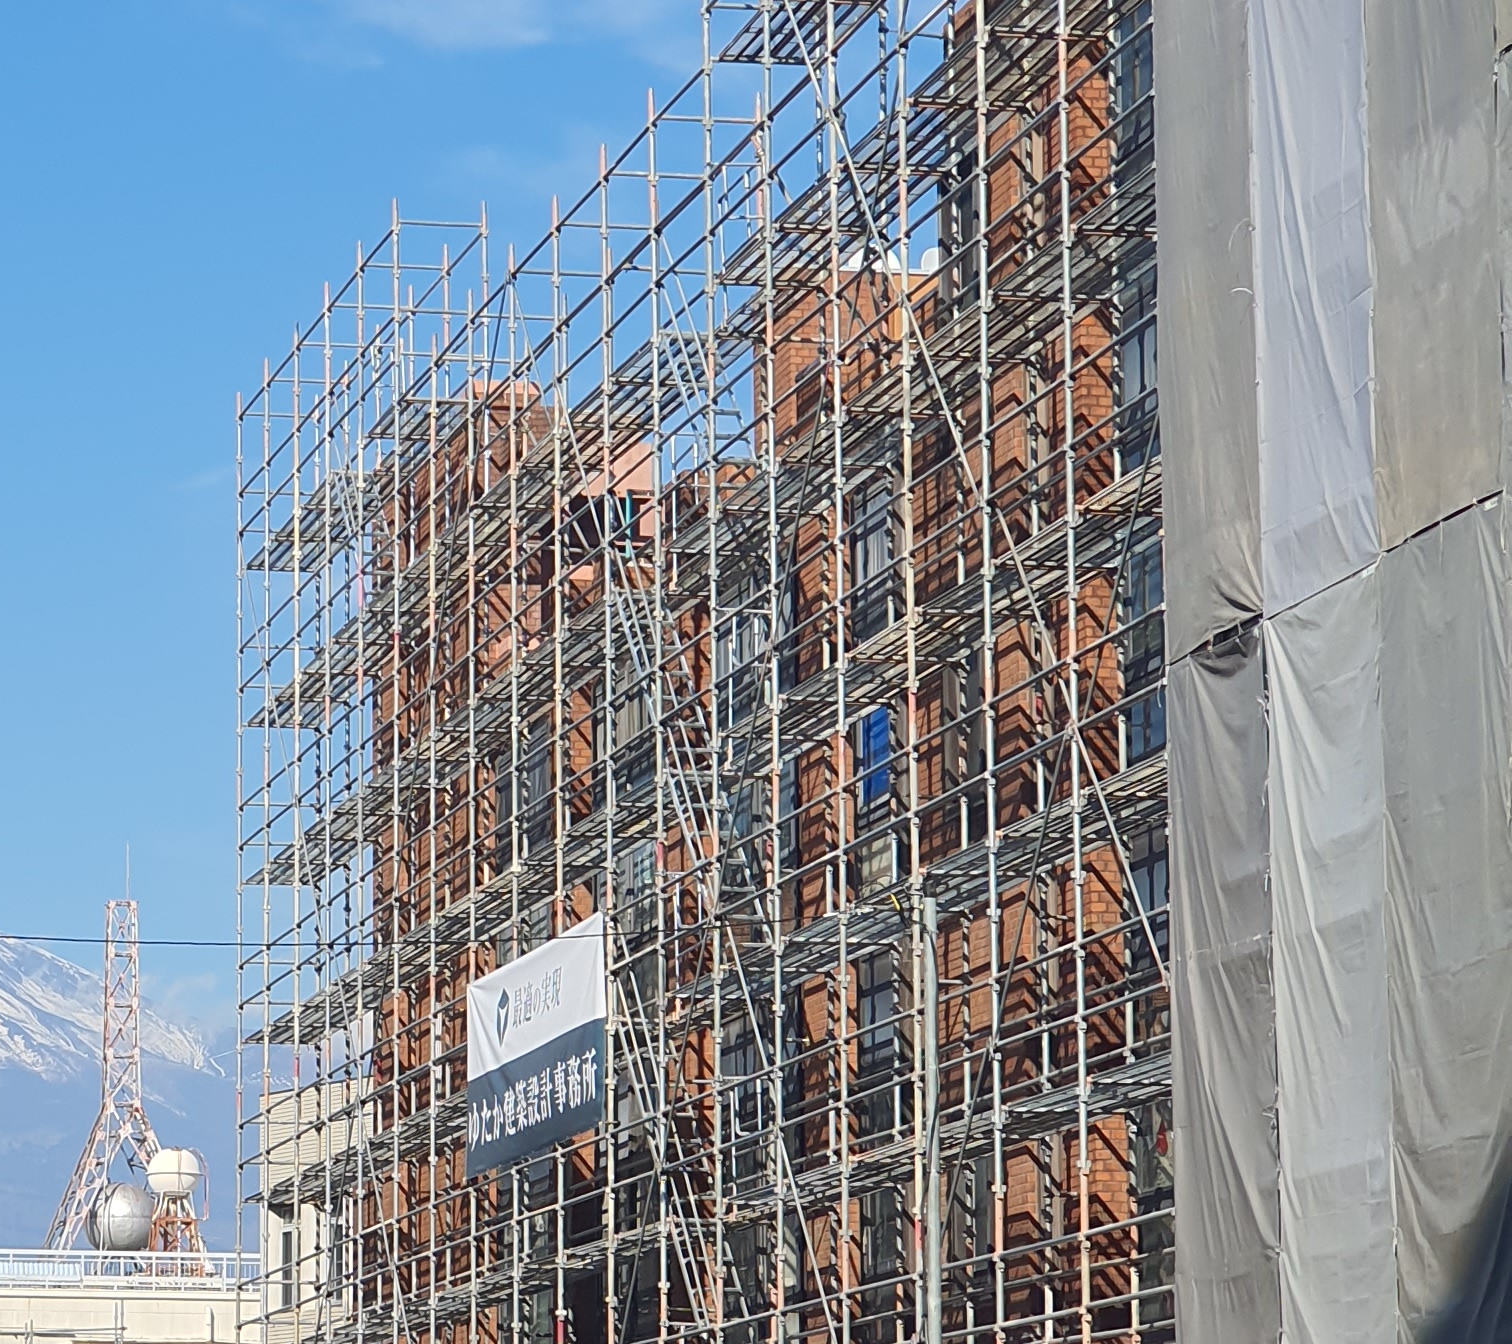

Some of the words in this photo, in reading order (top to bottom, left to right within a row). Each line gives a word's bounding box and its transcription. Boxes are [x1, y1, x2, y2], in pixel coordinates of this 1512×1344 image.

[468, 1048, 598, 1152] ゆたか建築設計事務所
